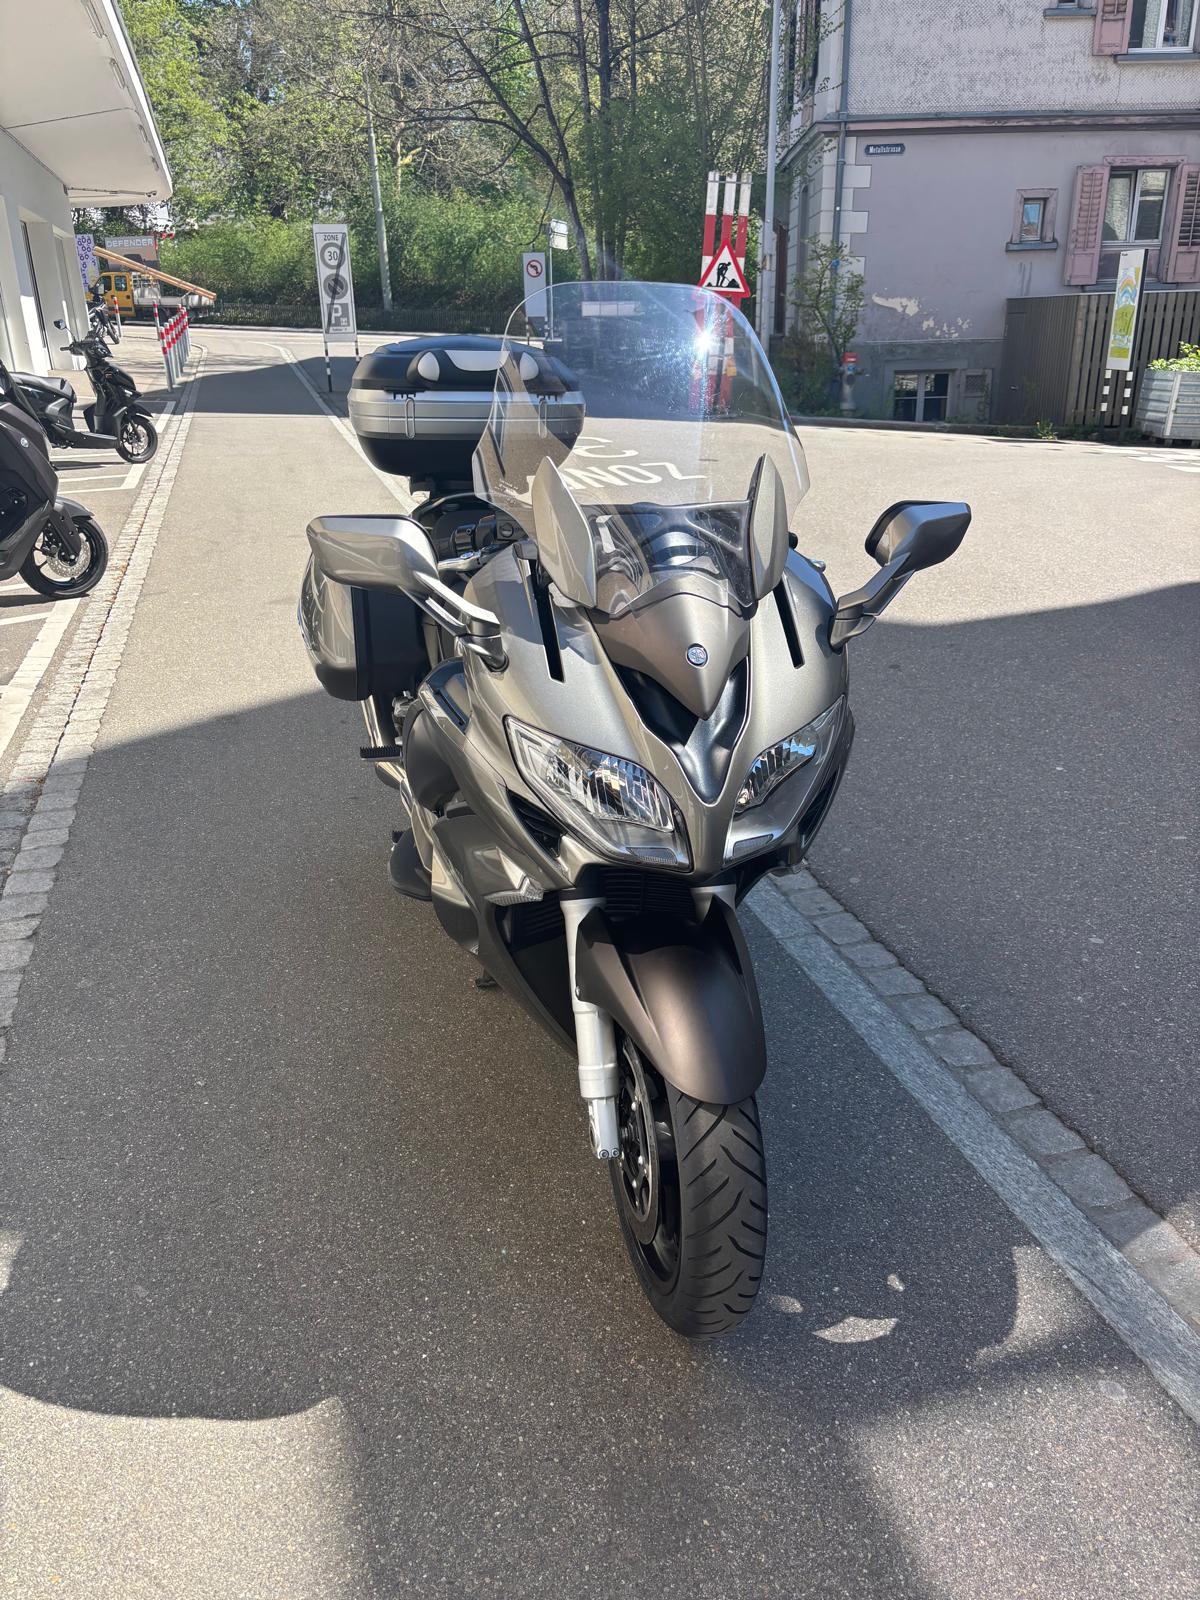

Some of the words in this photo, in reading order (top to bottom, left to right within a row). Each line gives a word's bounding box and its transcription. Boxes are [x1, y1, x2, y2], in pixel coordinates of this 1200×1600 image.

[106, 238, 154, 248] DEFENDER
[327, 250, 338, 261] 30
[571, 436, 639, 458] 3
